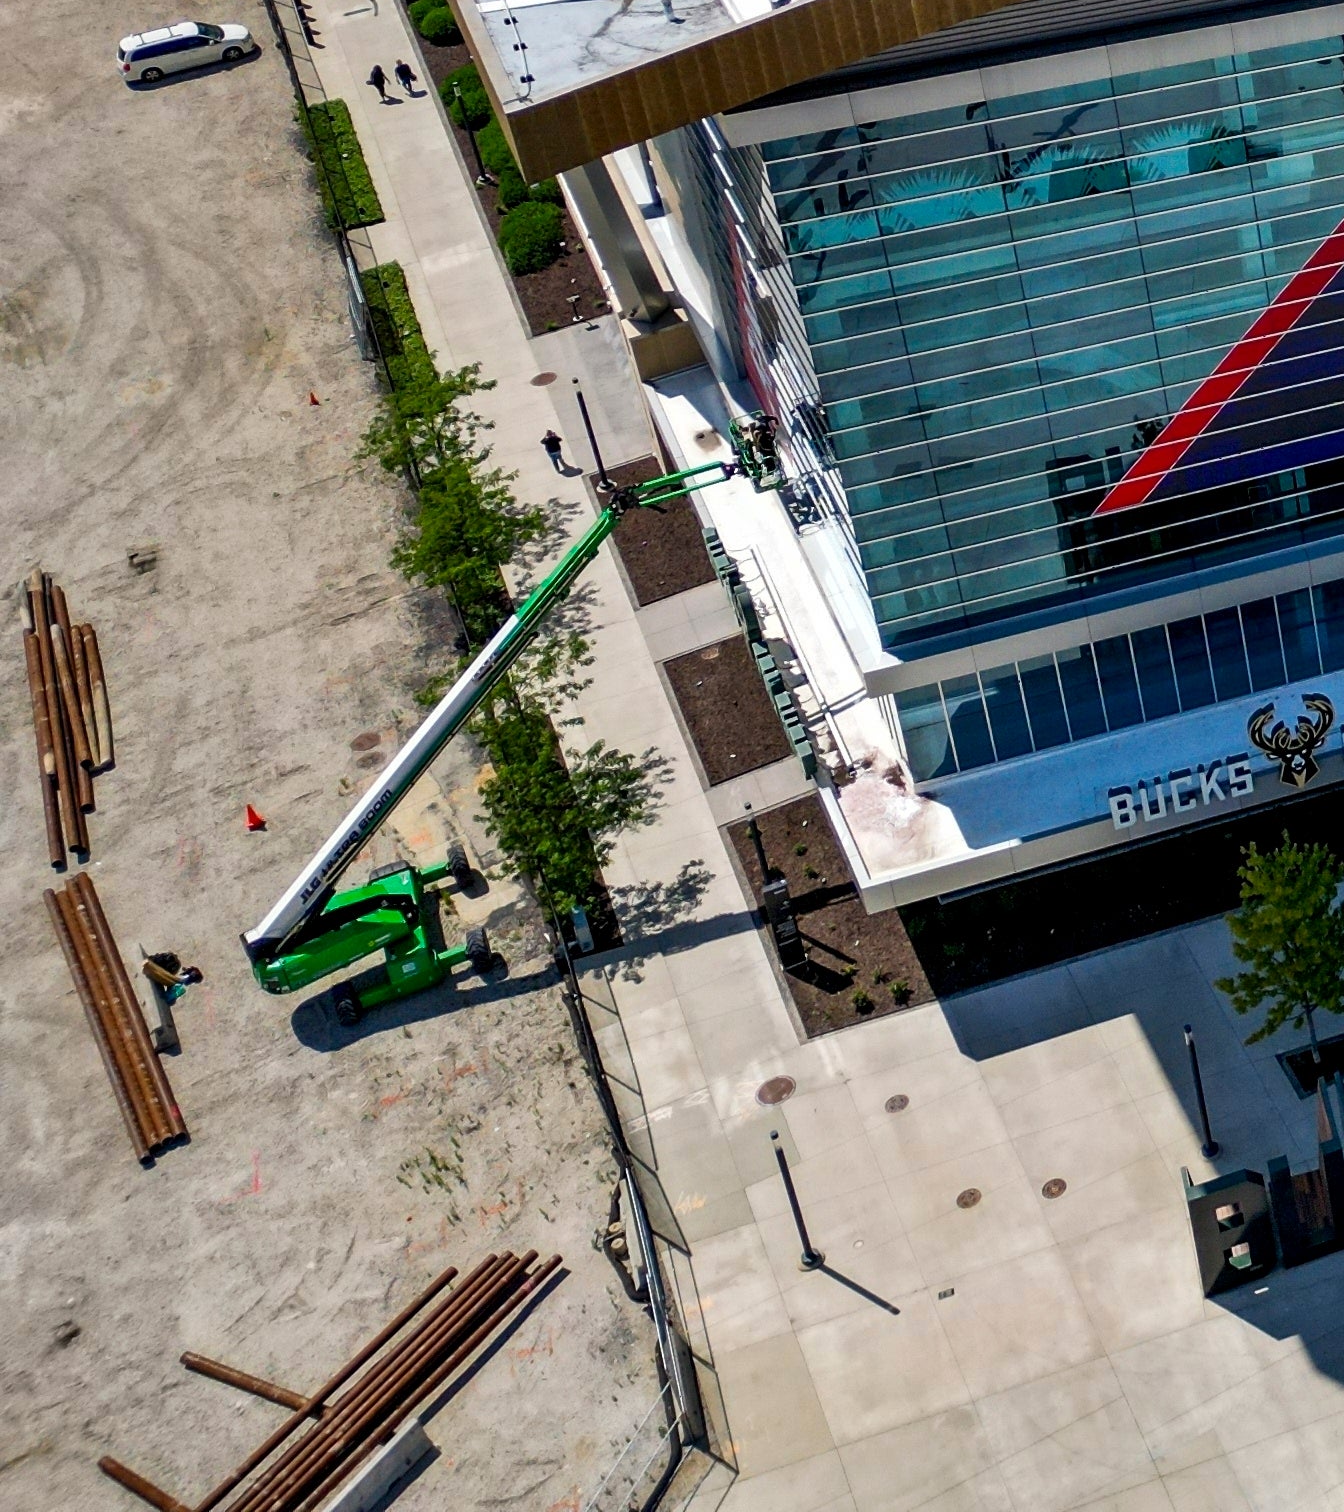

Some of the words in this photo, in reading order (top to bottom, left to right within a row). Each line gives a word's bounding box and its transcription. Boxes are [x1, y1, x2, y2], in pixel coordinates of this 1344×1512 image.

[1107, 760, 1255, 831] BUCKS
[299, 876, 321, 905] JLG
[358, 788, 393, 831] BOOM
